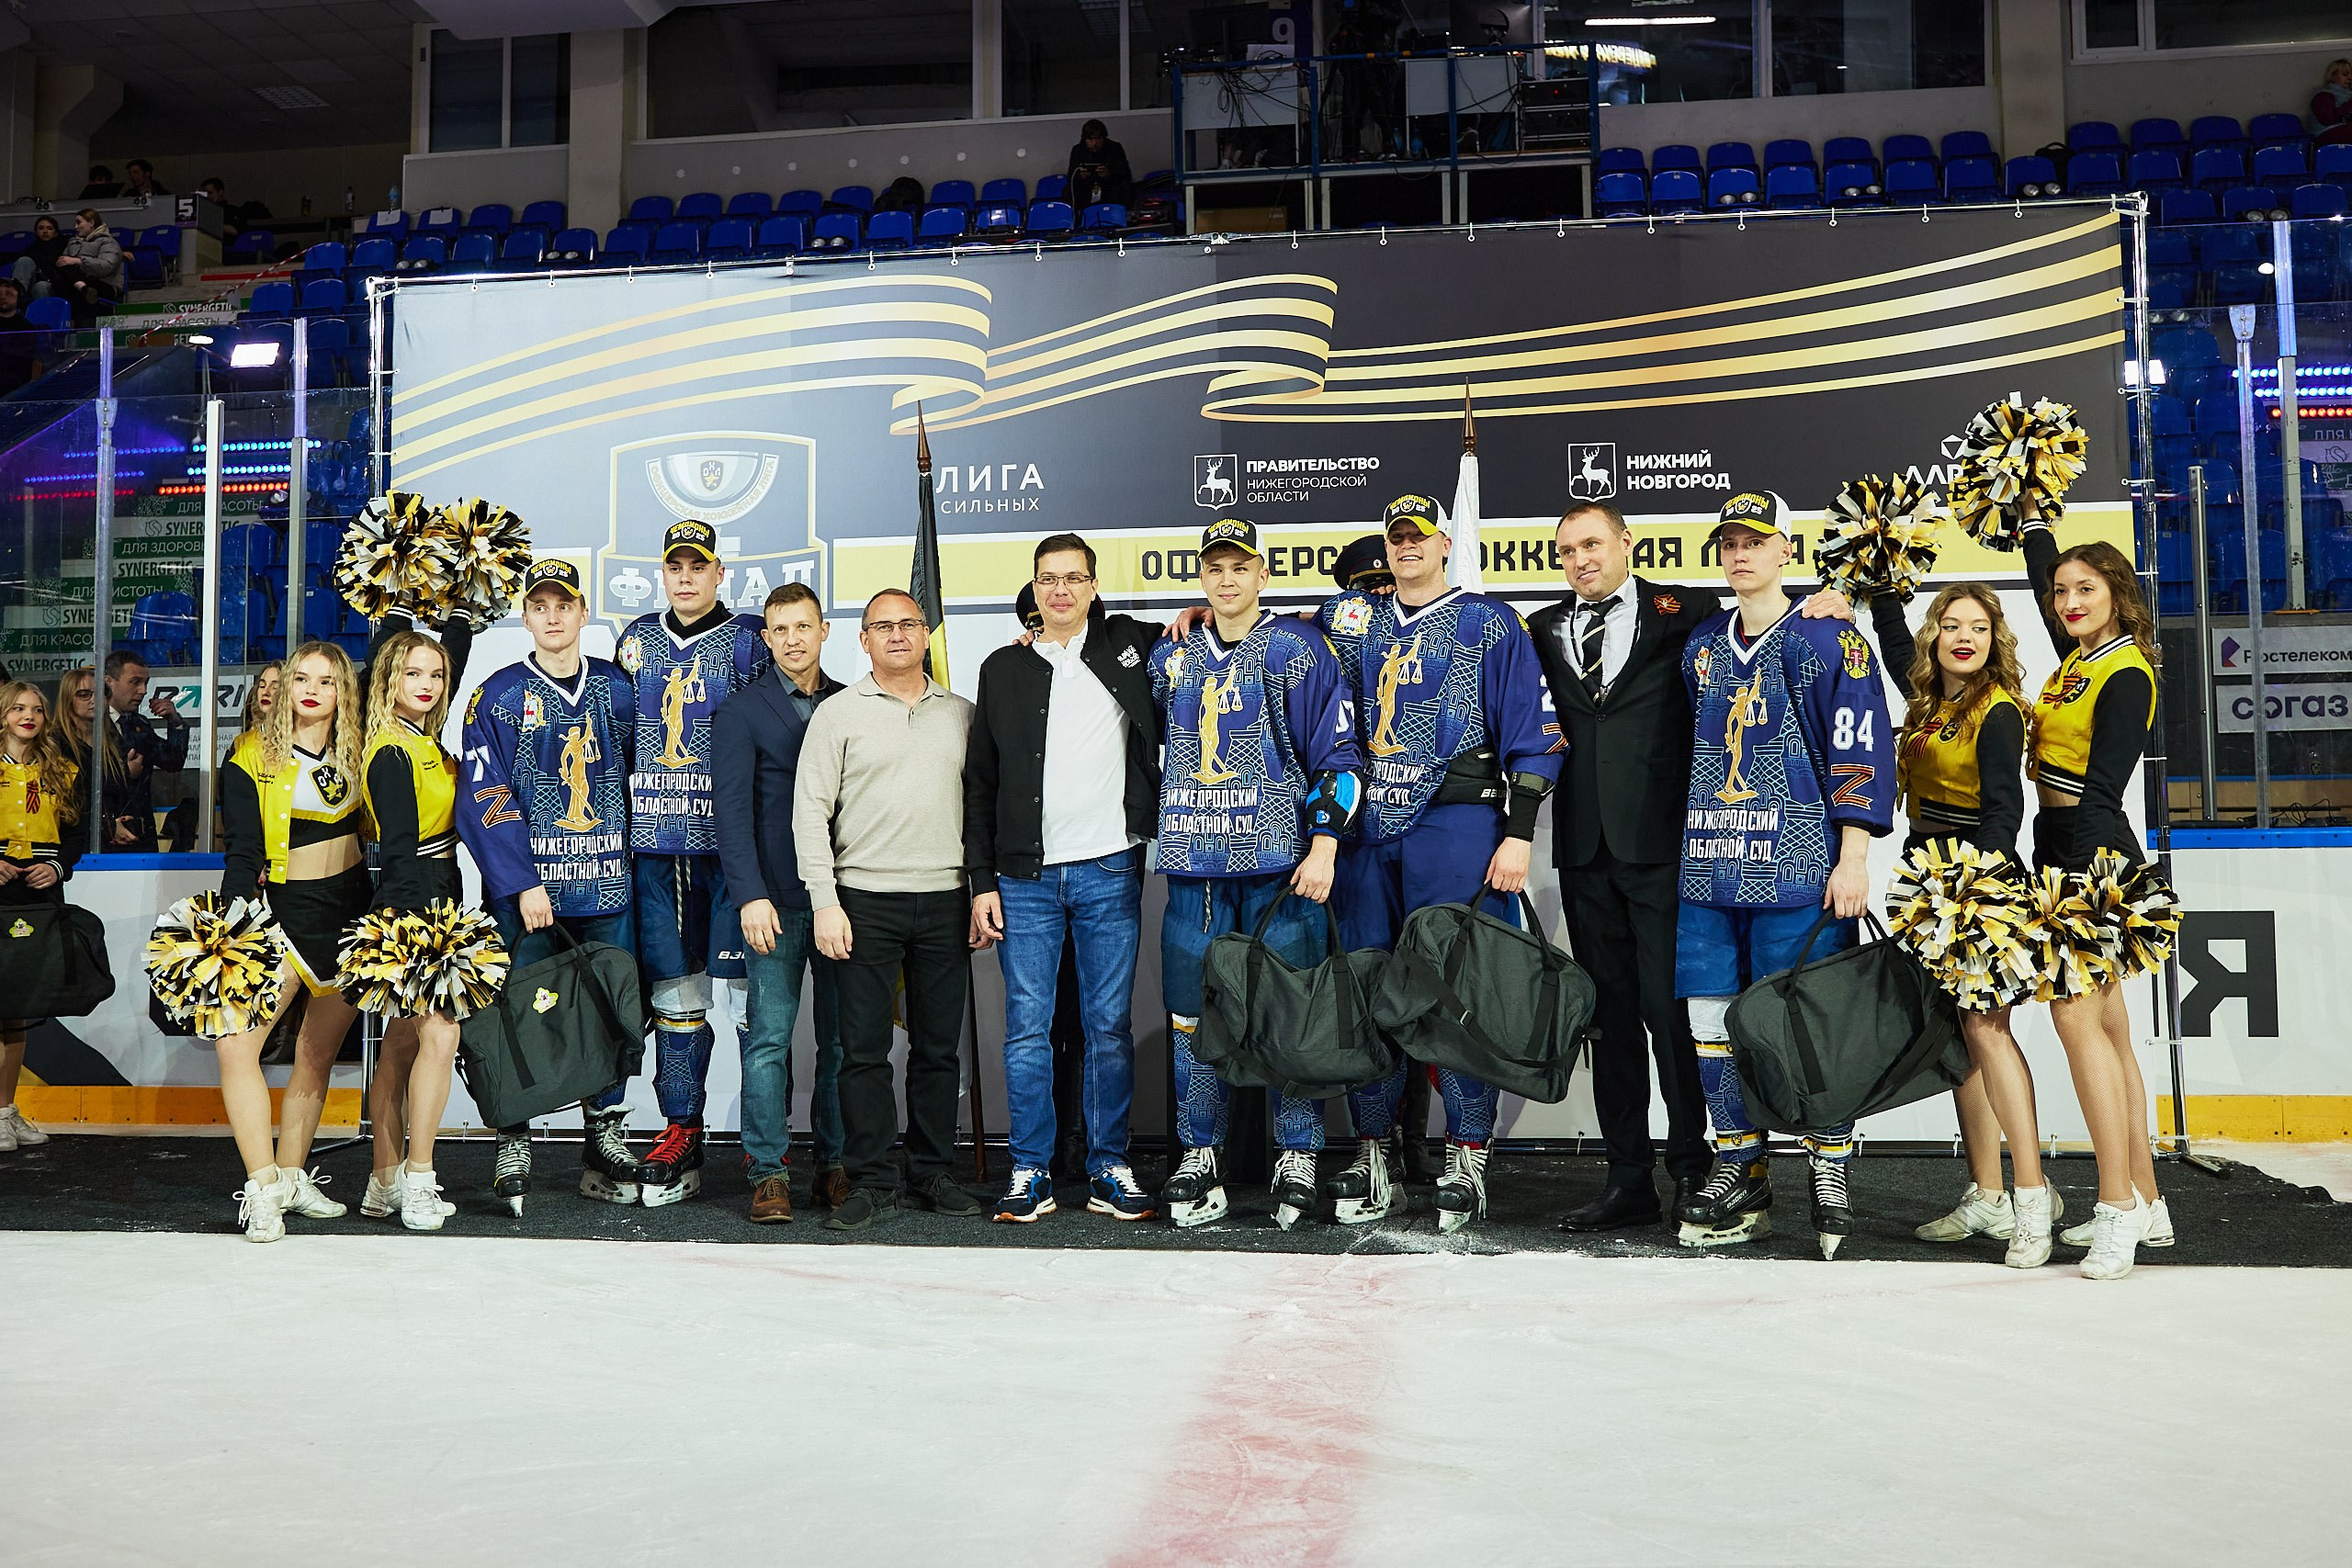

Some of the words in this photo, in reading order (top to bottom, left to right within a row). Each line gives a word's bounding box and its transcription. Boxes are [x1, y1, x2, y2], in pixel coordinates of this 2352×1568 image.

[178, 198, 193, 217] 5
[1246, 457, 1380, 473] ПРАВИТЕЛЬСТВО
[1626, 448, 1712, 470] НИЖНИЙ
[935, 463, 1046, 494] ЛИГА
[1247, 473, 1367, 490] НИЖЕГОРОДСКОЙ
[1626, 472, 1732, 491] НОВГОРОД
[940, 497, 1040, 514] СИЛЬНЫХ
[1246, 491, 1309, 503] ОБЛАСТИ
[177, 501, 203, 514] ДЛЯ
[121, 542, 148, 555] ДЛЯ
[151, 540, 204, 553] ЗДОРОВ
[118, 560, 193, 577] SYNERGETIC
[111, 583, 164, 597] ИСТОТЫ
[19, 634, 48, 648] ДЛЯ
[51, 632, 93, 646] КРАСО
[1833, 706, 1874, 752] 84
[1387, 788, 1411, 807] СУД
[1164, 813, 1231, 834] ОБЛАСТНОЙ
[1235, 814, 1253, 835] СУД
[529, 829, 623, 856] НИЖЕГОРОДСКИЙ
[1749, 840, 1772, 863] СУД
[603, 858, 622, 878] СУД
